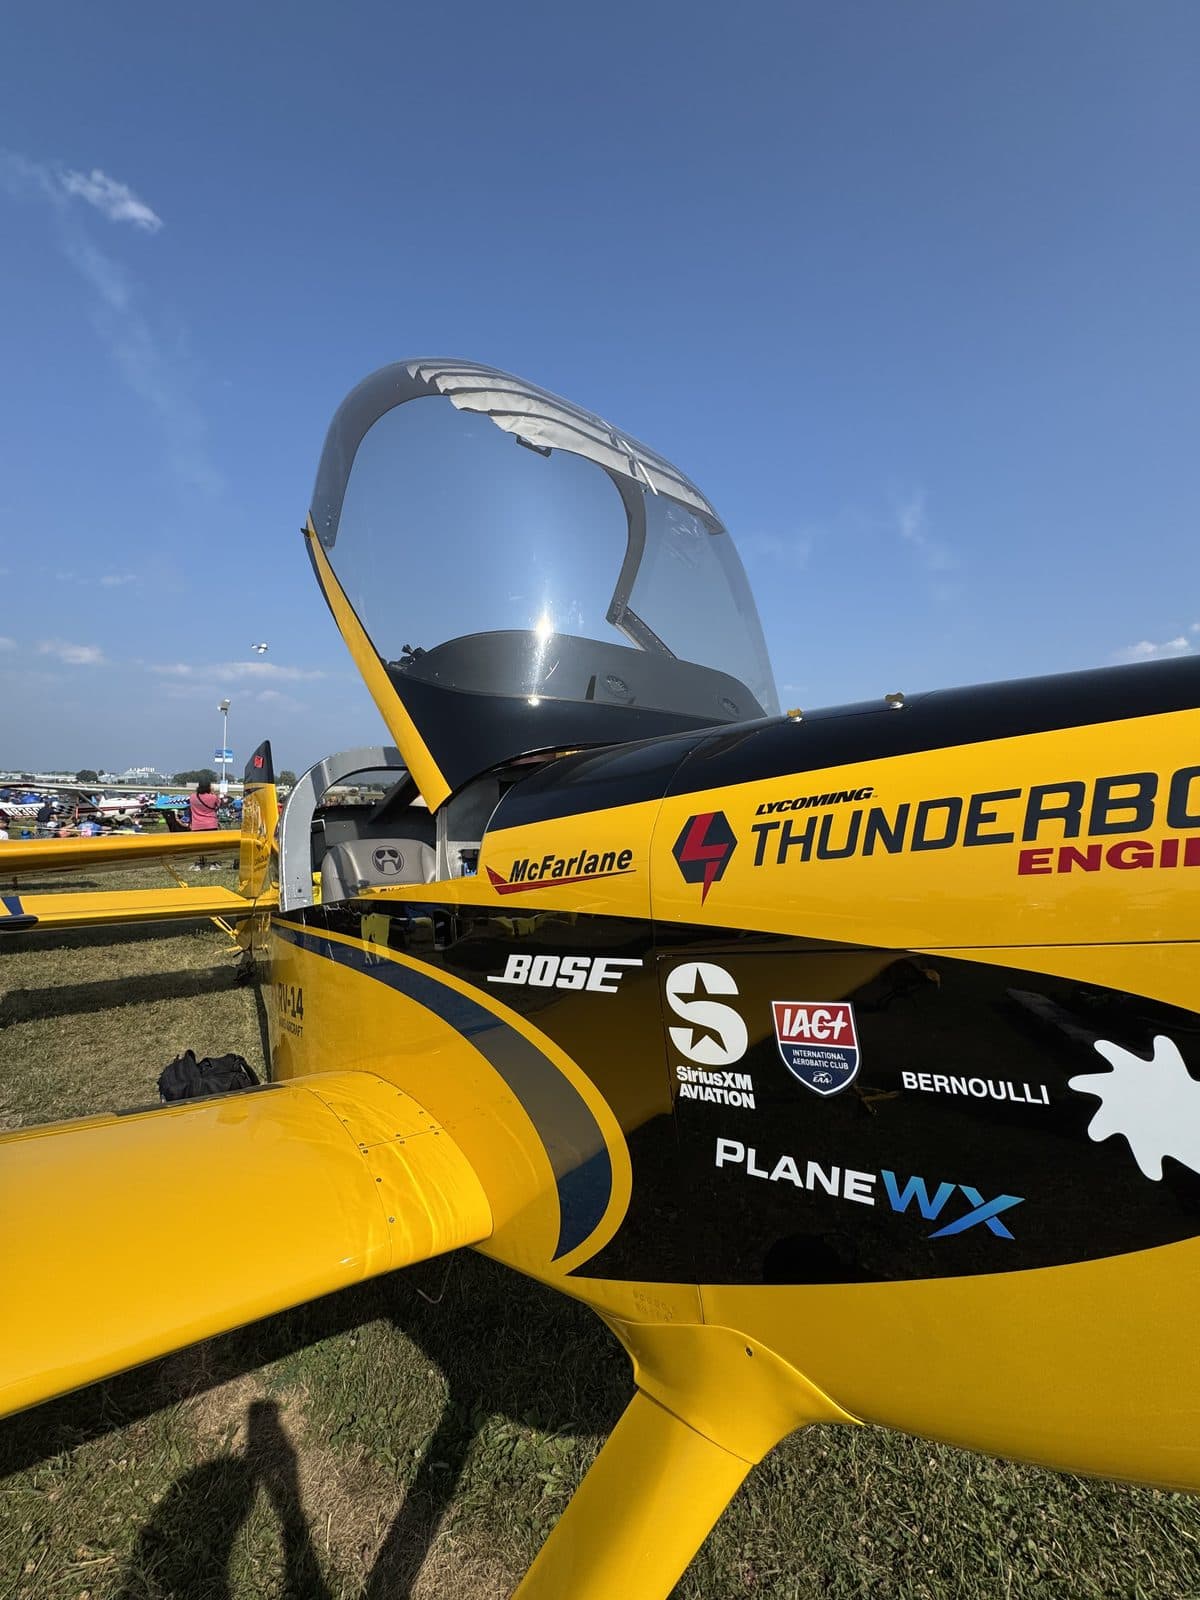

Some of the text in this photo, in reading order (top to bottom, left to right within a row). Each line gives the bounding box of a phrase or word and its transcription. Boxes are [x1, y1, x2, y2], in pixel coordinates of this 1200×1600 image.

[755, 787, 875, 816] LYCOMING
[509, 849, 633, 883] McFarlane
[487, 954, 643, 993] BOSE
[792, 1049, 847, 1061] INTERNATIONAL
[792, 1057, 849, 1070] AEROBATIC CLUB
[676, 1065, 753, 1091] SiriusXM
[901, 1071, 1050, 1105] BERNOULLI
[679, 1083, 756, 1110] AVIATION
